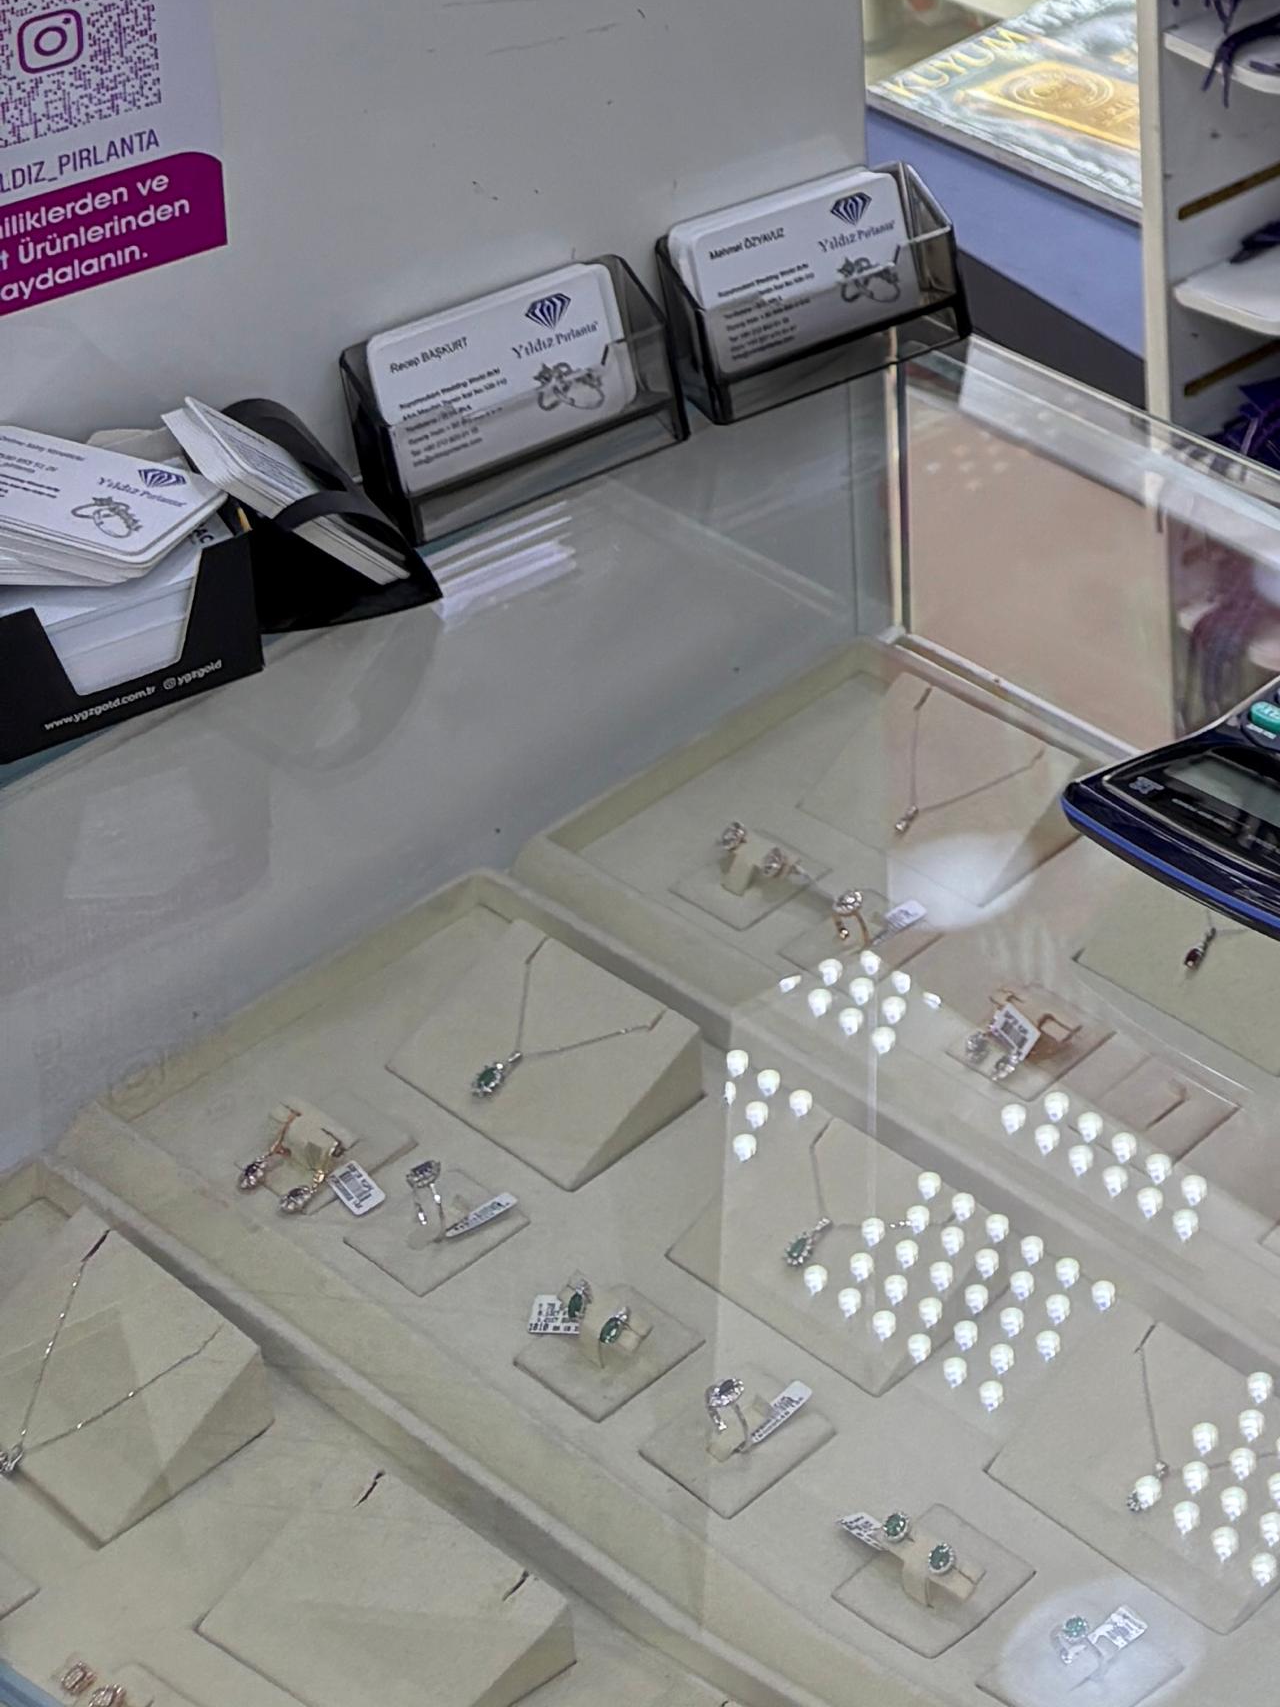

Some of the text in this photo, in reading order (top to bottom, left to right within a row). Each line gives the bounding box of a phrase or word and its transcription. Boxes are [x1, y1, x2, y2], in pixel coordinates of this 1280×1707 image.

[136, 175, 169, 197] ve
[18, 199, 190, 265] Ürünlerinden
[818, 233, 857, 254] Yıldız
[0, 246, 148, 301] aydalanın.
[390, 336, 468, 374] Recep BAŞKURT
[512, 337, 552, 359] Yıldız
